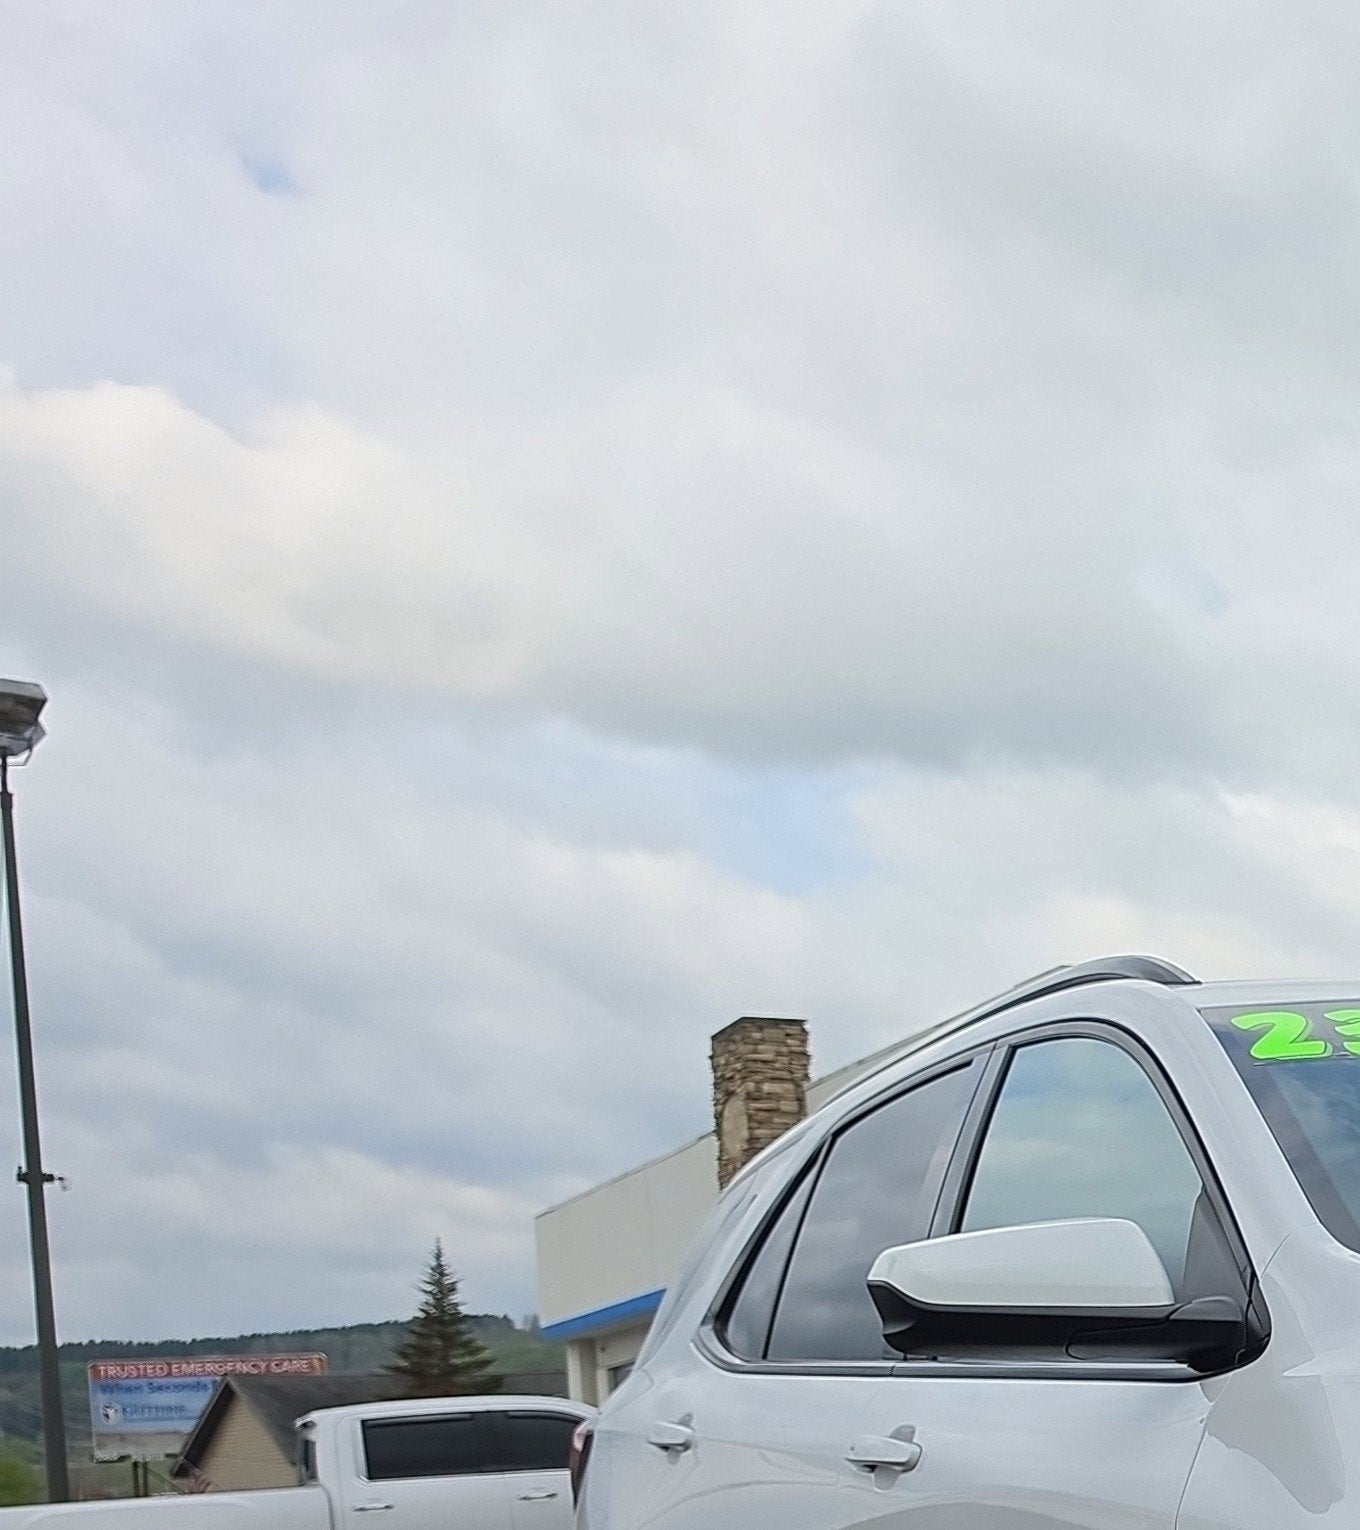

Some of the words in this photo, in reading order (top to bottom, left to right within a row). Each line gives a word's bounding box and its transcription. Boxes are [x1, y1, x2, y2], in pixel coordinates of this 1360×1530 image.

[98, 1363, 169, 1379] TRUSTED
[171, 1360, 269, 1376] EMERGENCY
[270, 1358, 310, 1373] CARE
